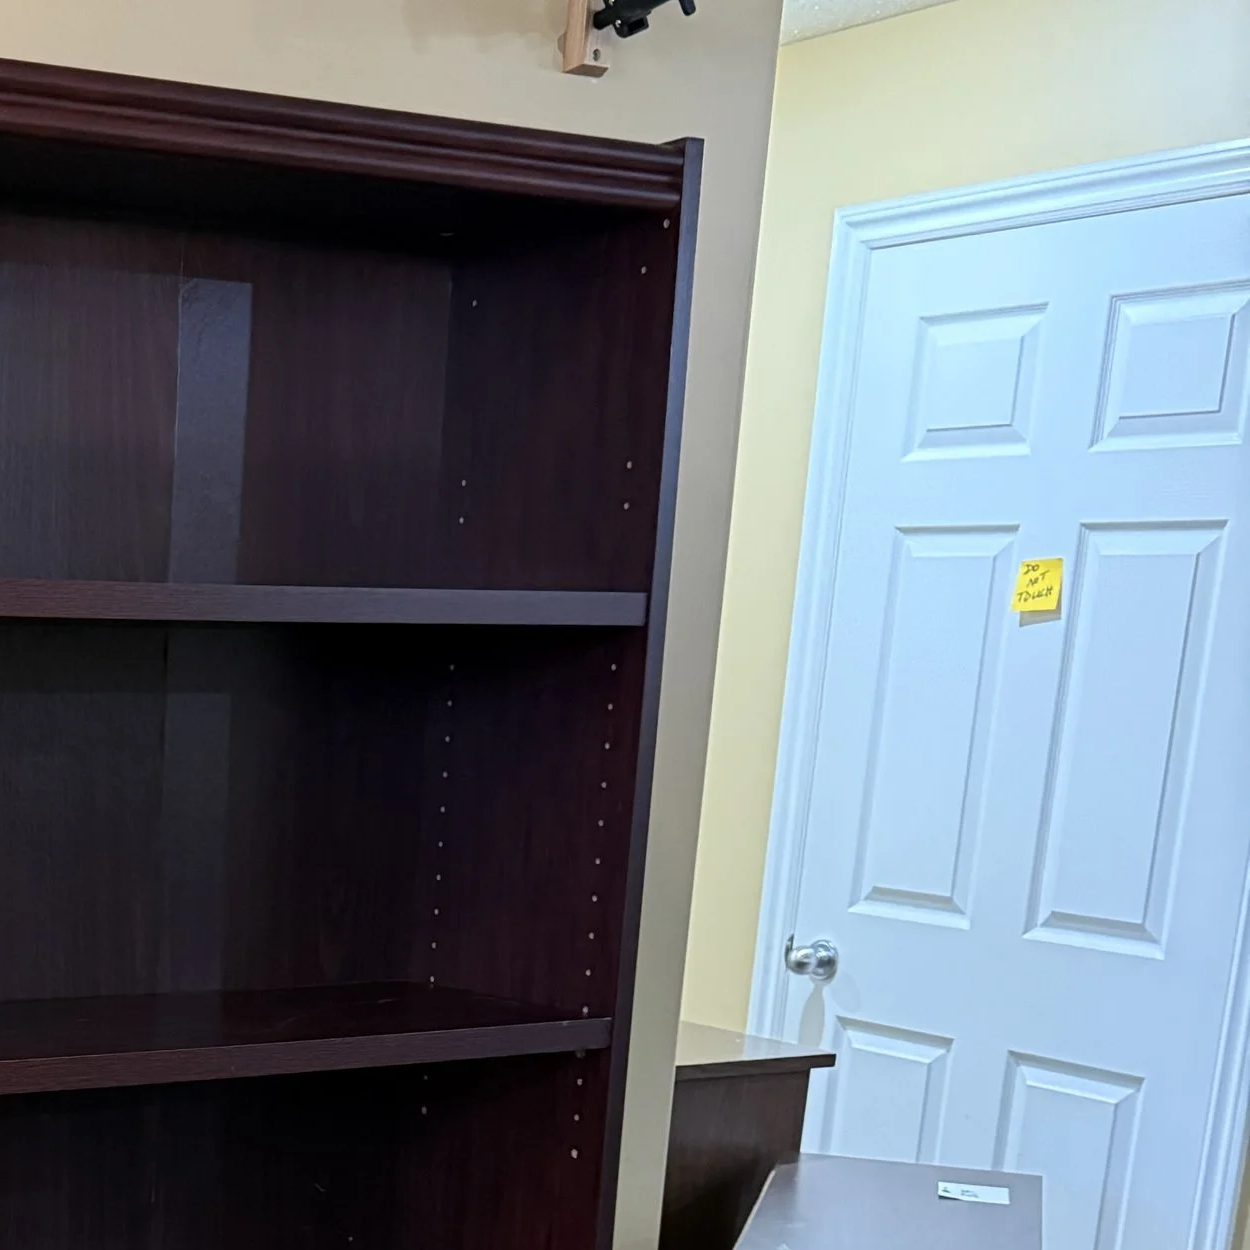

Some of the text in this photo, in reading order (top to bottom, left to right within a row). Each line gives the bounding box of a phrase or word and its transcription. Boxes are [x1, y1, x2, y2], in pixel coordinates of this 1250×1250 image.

[1022, 563, 1040, 575] DO
[1026, 569, 1050, 588] NOT
[1016, 585, 1053, 603] TOUCH
